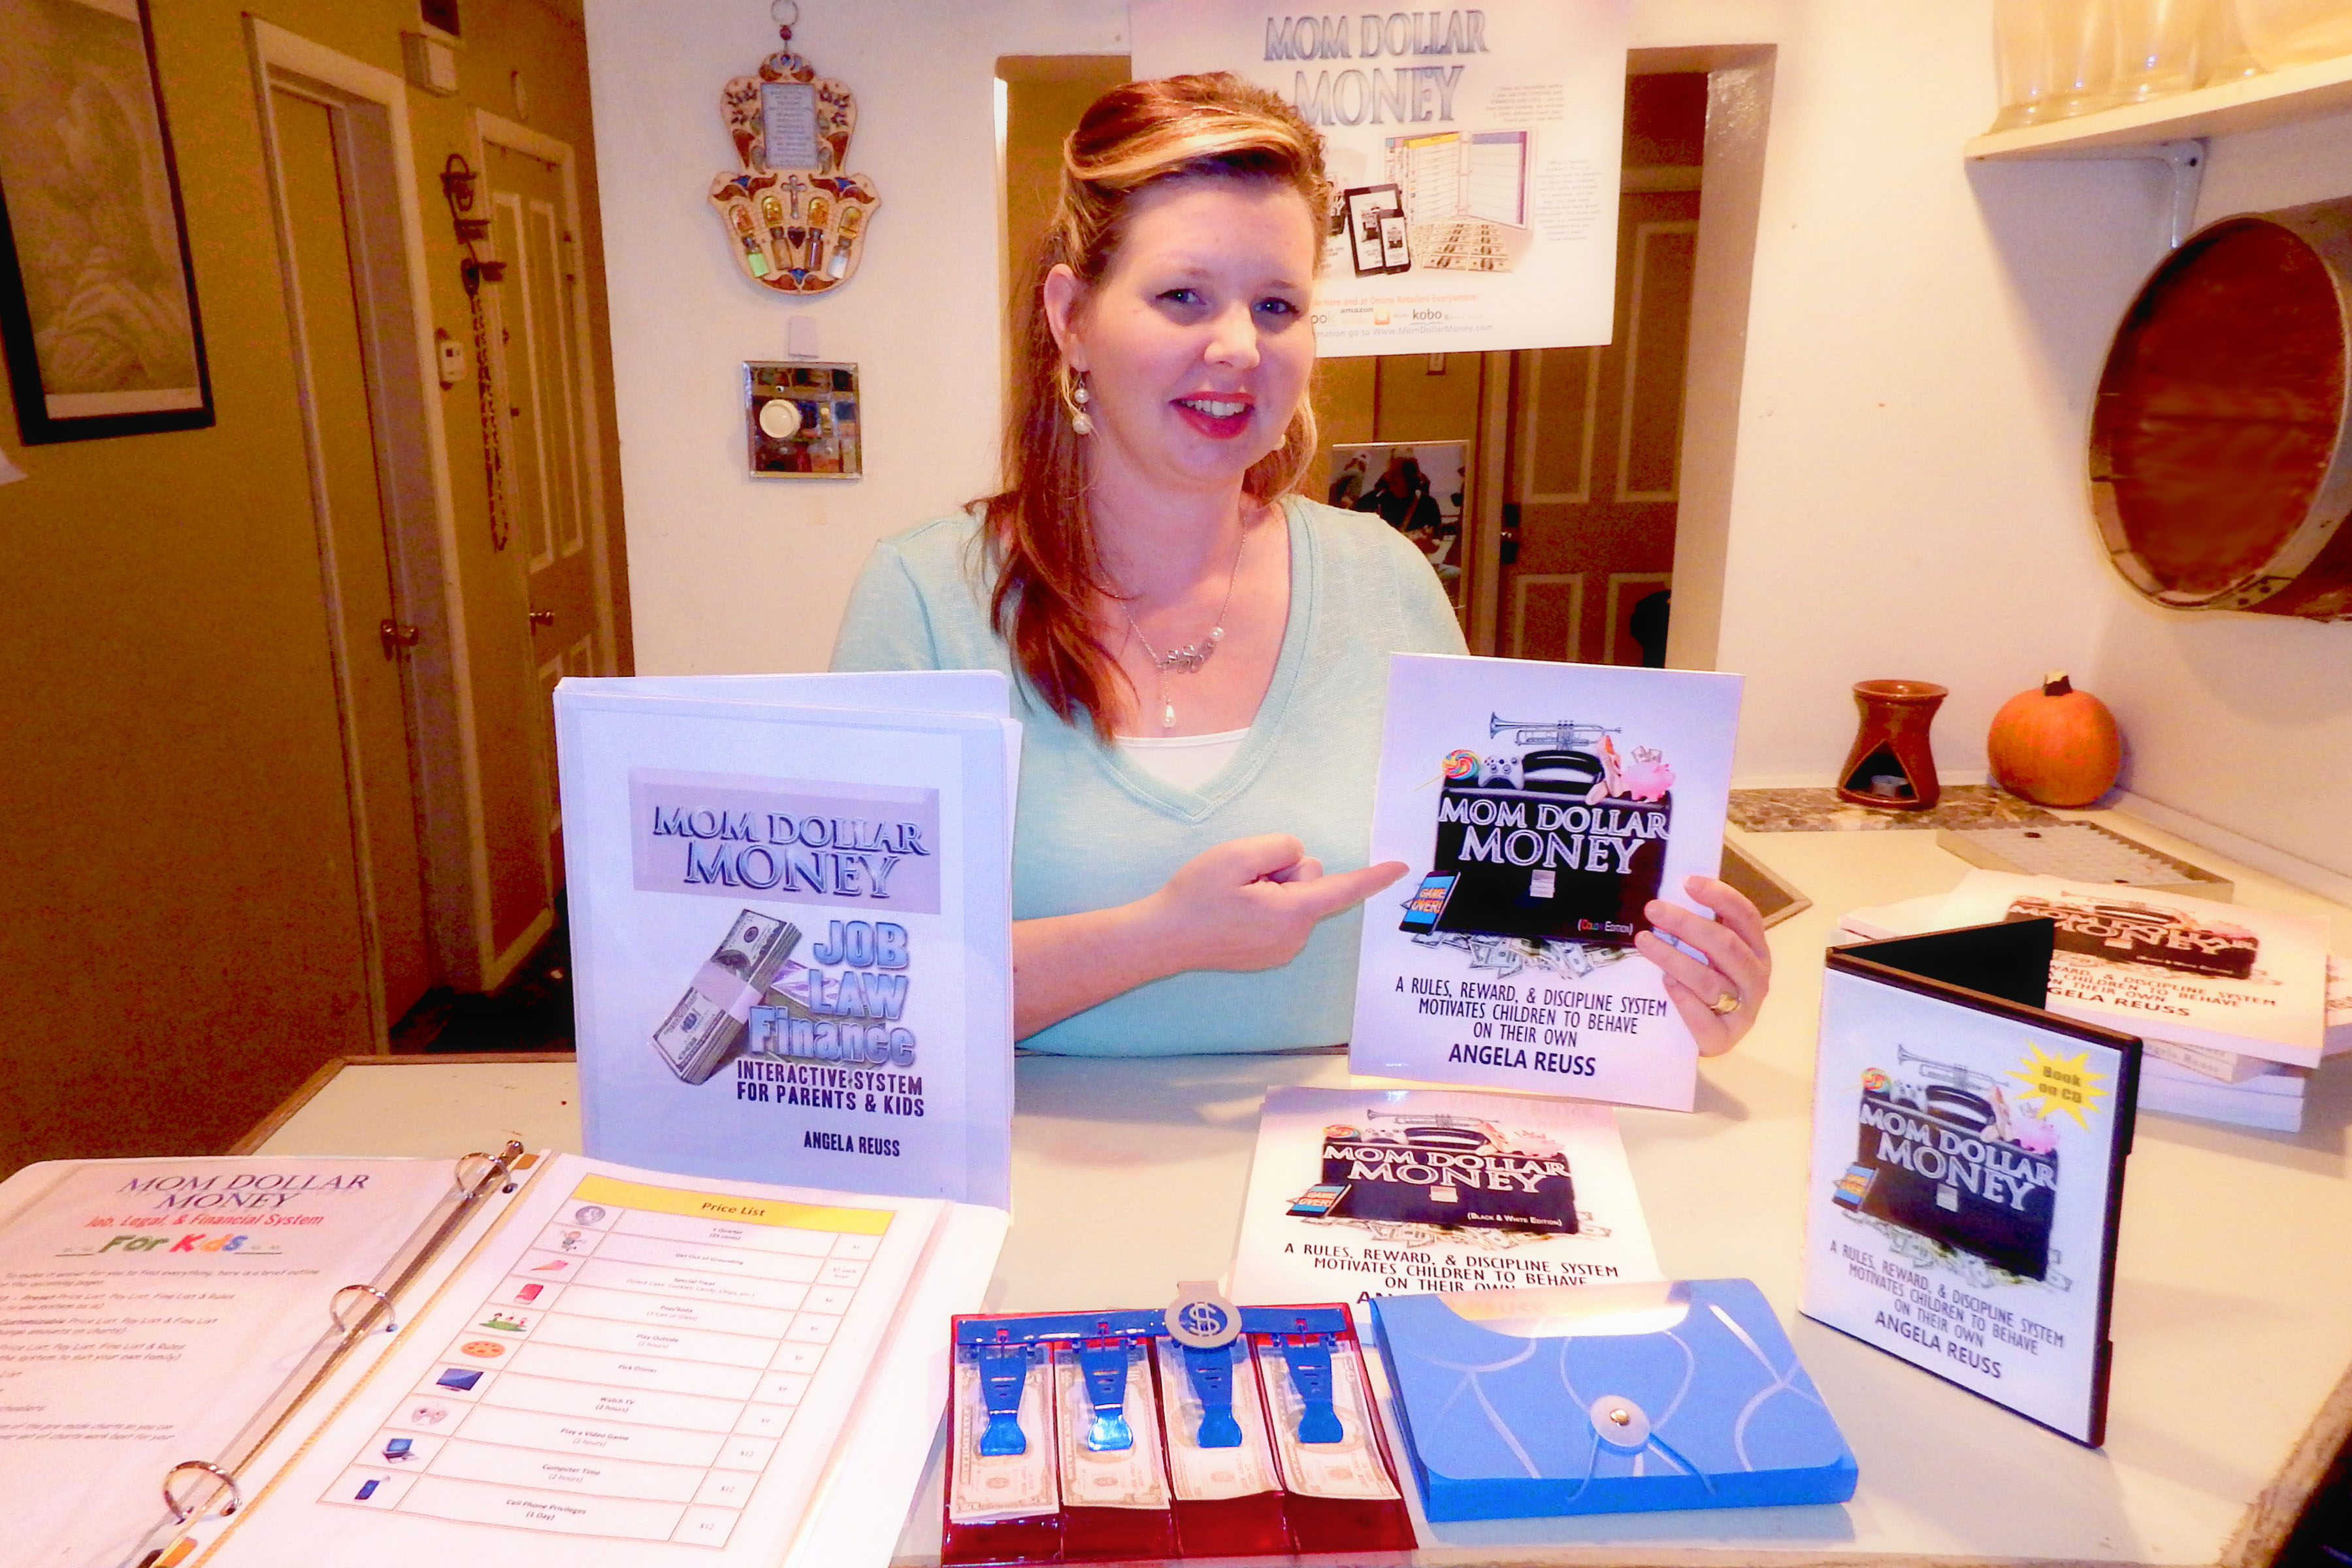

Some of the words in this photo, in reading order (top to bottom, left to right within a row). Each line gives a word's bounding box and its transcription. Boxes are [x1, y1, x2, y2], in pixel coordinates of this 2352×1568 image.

[1264, 16, 1352, 61] MOM
[1359, 10, 1490, 57] DOLLAR
[1294, 65, 1465, 126] MONEY
[1413, 308, 1442, 320] kobo
[1348, 329, 1359, 338] go
[653, 806, 759, 841] MOM
[767, 813, 930, 855] DOLLAR
[1439, 797, 1526, 828] MOM
[1535, 804, 1671, 840] DOLLAR
[1458, 825, 1645, 874] MONEY
[683, 840, 900, 899] MONEY
[1419, 887, 1446, 899] GAME
[813, 920, 909, 969] JOB
[808, 969, 909, 1019] LAW
[1396, 976, 1403, 992] A
[1411, 977, 1452, 998] RULES,
[1461, 982, 1518, 1004] REWARD,
[1526, 987, 1536, 1003] &
[1544, 989, 1612, 1011] DISCIPLINE
[1621, 997, 1667, 1017] SYSTEM
[2047, 987, 2104, 1002] GELA
[2114, 998, 2191, 1017] REUSS
[2064, 973, 2138, 990] CHILDREN
[2150, 986, 2168, 995] TO
[2178, 991, 2242, 1007] BEHAVE
[2073, 982, 2116, 995] THEIR
[2125, 990, 2165, 1002] OWN
[2124, 976, 2206, 994] DISCIPLINE
[2218, 991, 2276, 1006] SYSTEM
[1419, 998, 1485, 1019] MOTIVATES
[1493, 1004, 1555, 1025] CHILDREN
[1564, 1011, 1580, 1028] TO
[1588, 1013, 1638, 1034] BEHAVE
[749, 1005, 916, 1066] Finance
[1474, 1022, 1492, 1037] ON
[1500, 1024, 1536, 1043] THEIR
[1544, 1030, 1577, 1047] OWN
[1448, 1043, 1527, 1069] ANGELA
[1534, 1051, 1596, 1076] REUSS
[737, 1060, 847, 1088] INTERACTIVE
[853, 1071, 923, 1095] SYSTEM
[2042, 1066, 2081, 1087] Book
[737, 1082, 769, 1102] FOR
[777, 1085, 856, 1110] PARENTS
[865, 1097, 876, 1112] &
[884, 1096, 924, 1117] KIDS
[804, 1131, 854, 1153] ANGELA
[858, 1137, 900, 1156] REUSS
[1859, 1104, 1932, 1147] MOM
[1938, 1128, 2057, 1191] DOLLAR
[1324, 1145, 1416, 1165] MOM
[1426, 1152, 1569, 1176] DOLLAR
[1877, 1132, 2034, 1211] MONEY
[118, 1175, 220, 1192] MOM
[223, 1174, 370, 1192] DOLLAR
[1348, 1161, 1546, 1194] MONEY
[153, 1193, 300, 1209] MONEY
[701, 1201, 737, 1213] Price
[740, 1206, 766, 1217] List
[173, 1215, 185, 1226] &
[188, 1214, 262, 1226] Financial
[264, 1213, 325, 1226] System
[98, 1235, 169, 1254] For
[1284, 1243, 1294, 1254] A
[1445, 1254, 1456, 1266] &
[1467, 1256, 1550, 1272] DISCIPLINE
[1561, 1262, 1618, 1278] SYSTEM
[1314, 1257, 1396, 1275] MOTIVATES
[1407, 1265, 1484, 1281] CHILDREN
[1495, 1271, 1514, 1282] TO
[1385, 1277, 1407, 1288] ON
[1420, 1279, 1463, 1293] THEIR
[1830, 1240, 1837, 1254] A
[1938, 1284, 1946, 1298] &
[1952, 1290, 2014, 1328] DISCIPLINE
[2021, 1318, 2065, 1348] SYSTEM
[1848, 1263, 1904, 1297] MOTIVATES
[1910, 1289, 1963, 1323] CHILDREN
[1971, 1314, 1985, 1331] TO
[1992, 1324, 2038, 1356] BEHAVE
[1895, 1299, 1910, 1316] ON
[1917, 1307, 1948, 1333] THEIR
[1954, 1324, 1984, 1348] OWN
[1874, 1311, 1941, 1352] ANGELA
[1947, 1341, 2001, 1379] REUSS
[560, 1428, 577, 1436] Play
[607, 1433, 629, 1441] Game
[542, 1463, 580, 1475] Computer
[582, 1467, 601, 1476] Time
[523, 1500, 547, 1509] Phone
[549, 1503, 587, 1515] Privileges
[536, 1511, 555, 1522] Day)
